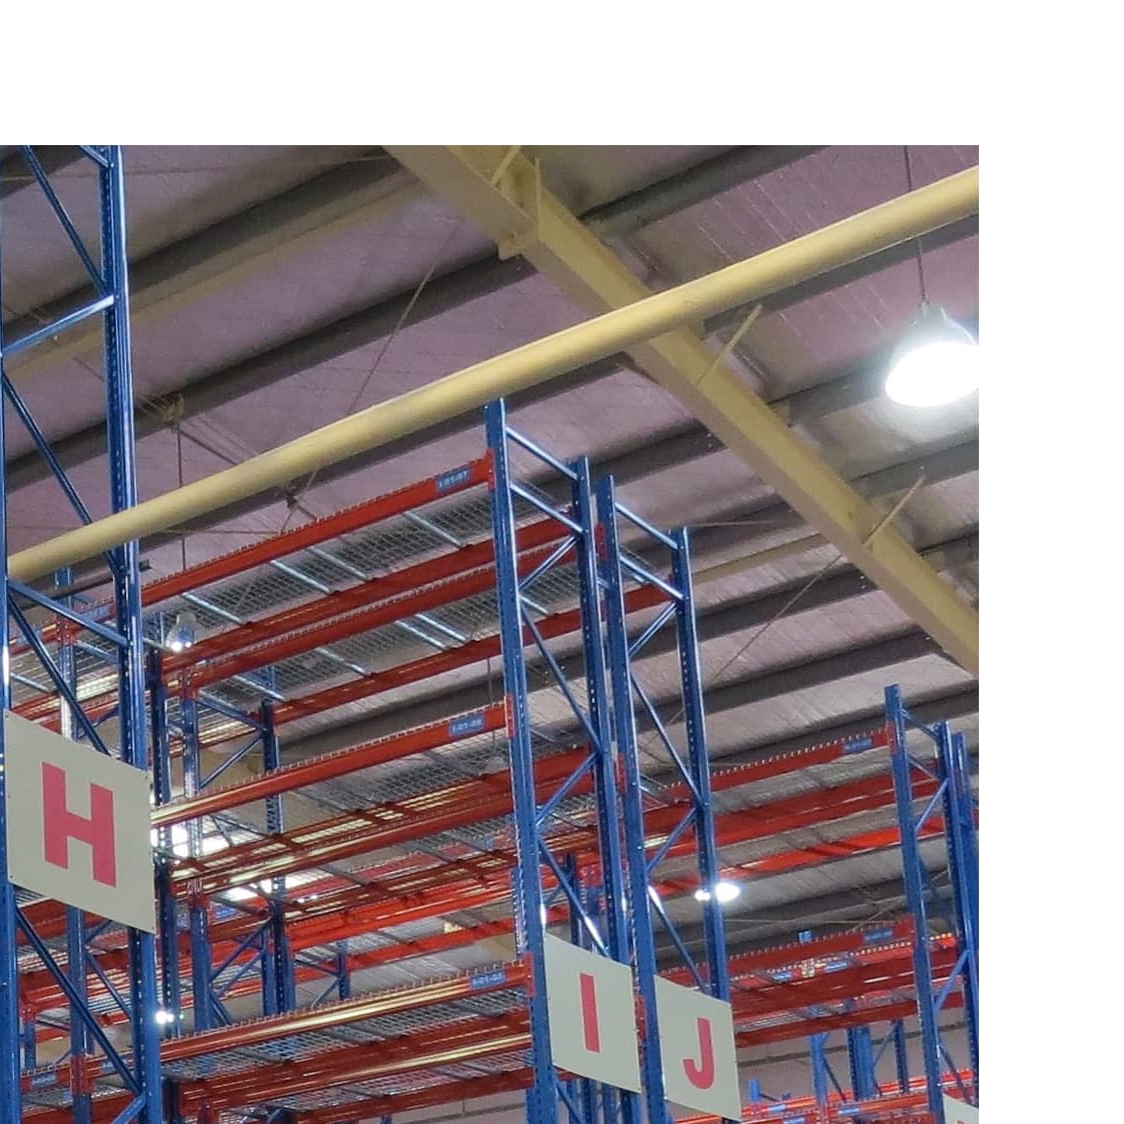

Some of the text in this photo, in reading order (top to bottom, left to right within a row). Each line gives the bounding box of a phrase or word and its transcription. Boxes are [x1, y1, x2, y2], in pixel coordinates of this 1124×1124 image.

[42, 762, 116, 888] H
[580, 973, 601, 1053] I
[683, 1016, 715, 1089] J
